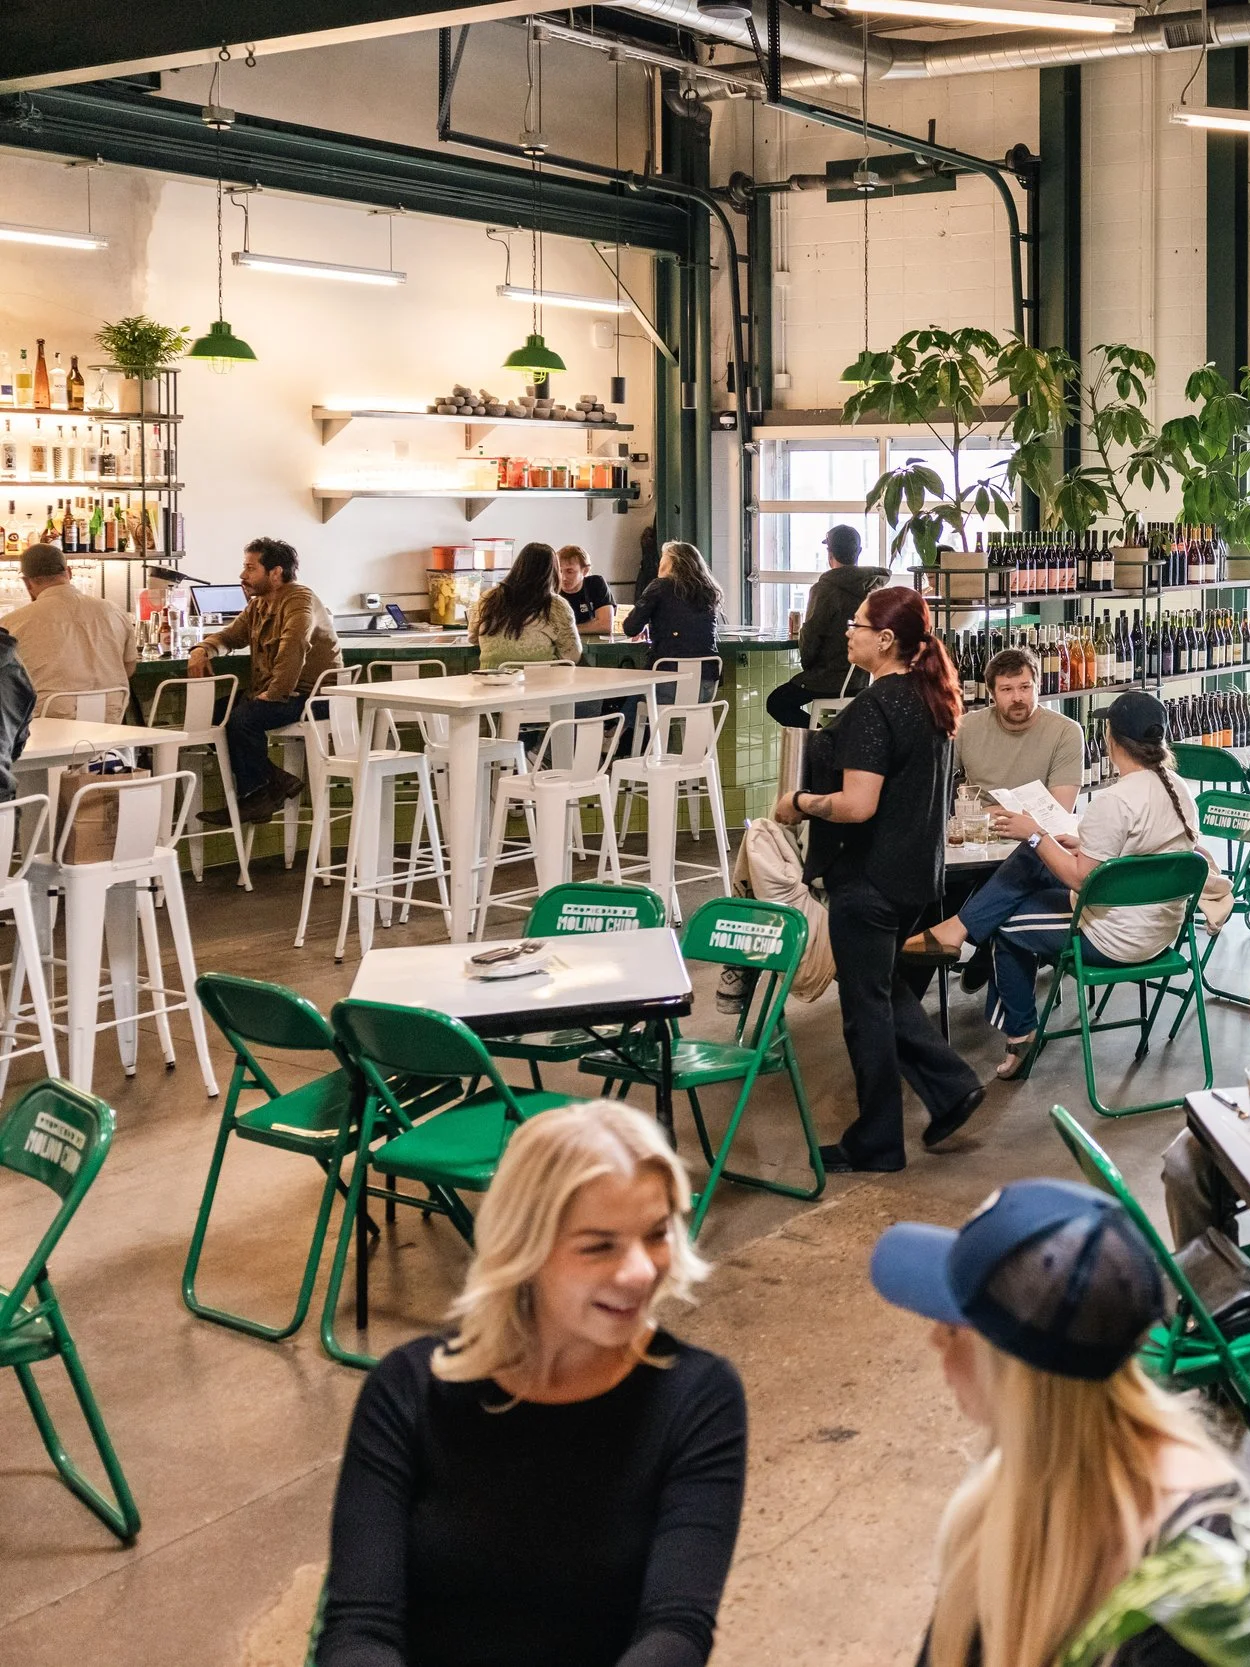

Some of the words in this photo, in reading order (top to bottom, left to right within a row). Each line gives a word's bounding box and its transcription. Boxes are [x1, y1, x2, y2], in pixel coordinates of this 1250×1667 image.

[1203, 813, 1232, 829] MOLINO
[566, 906, 618, 915] PROPIEDAD
[556, 915, 604, 932] MOLINO
[605, 917, 640, 933] CHIDO
[720, 922, 766, 934] PROPIEDAD
[709, 931, 753, 952] MOLINO
[752, 935, 784, 955] CHIDO
